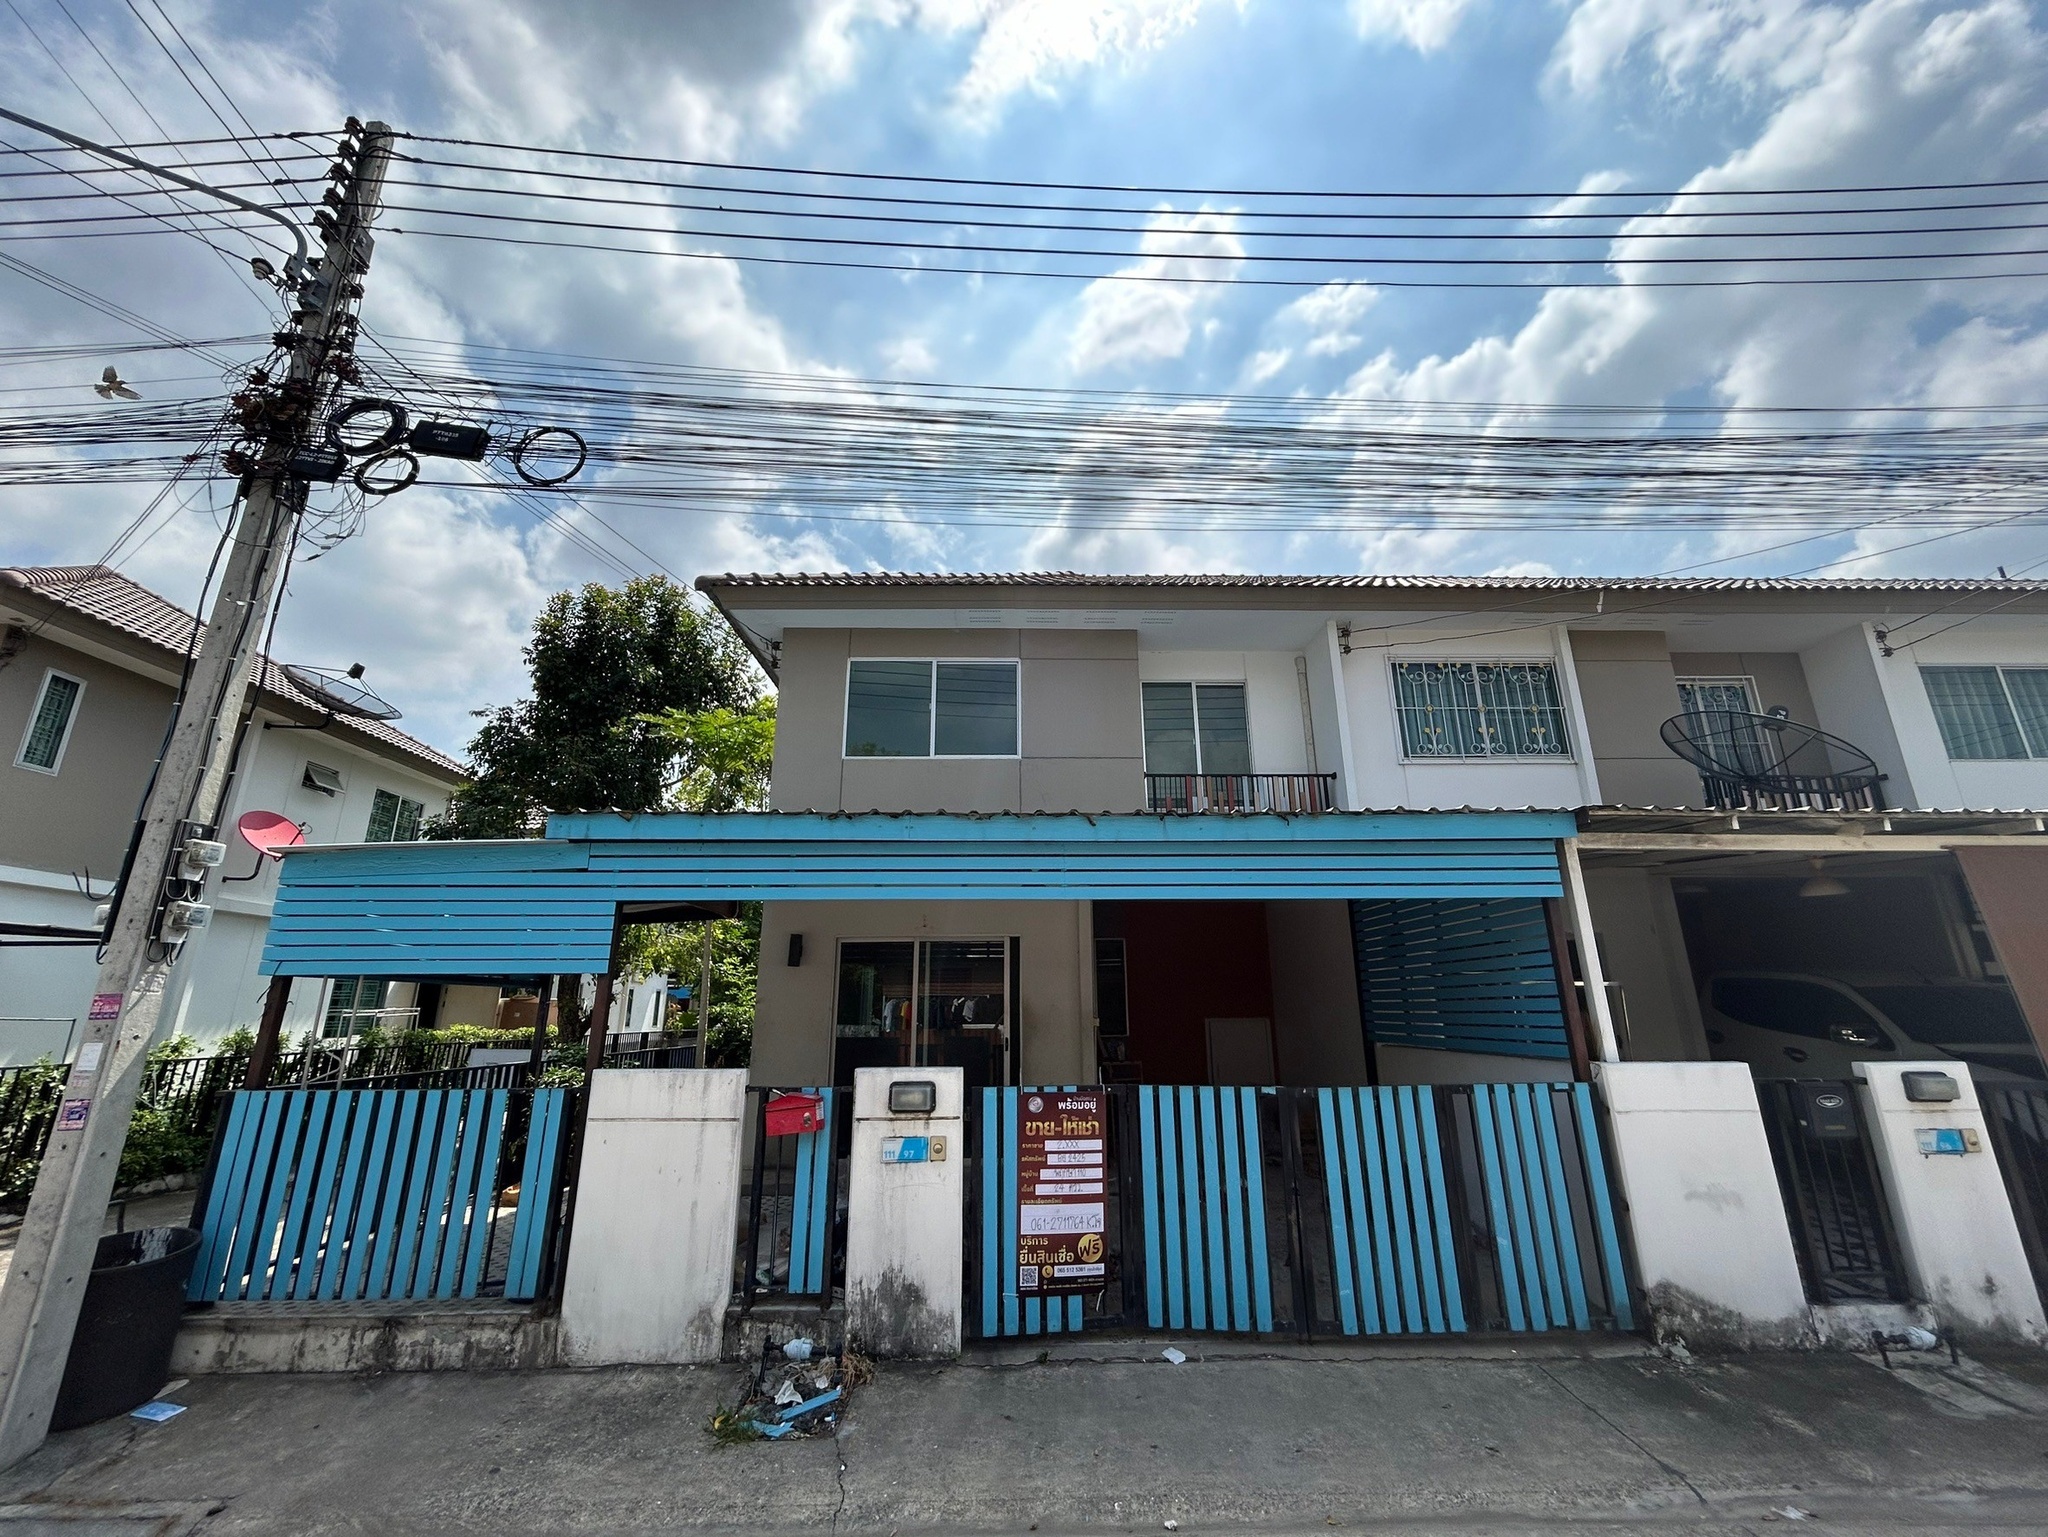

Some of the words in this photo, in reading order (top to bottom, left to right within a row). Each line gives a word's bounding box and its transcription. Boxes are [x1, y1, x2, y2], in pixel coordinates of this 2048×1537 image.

[1058, 1098, 1096, 1113] พร้อมอยู่
[1026, 1114, 1099, 1136] ขาย-ให้เช่า
[904, 1150, 914, 1158] 97
[1021, 1169, 1039, 1179] หมู่บ้าน
[1020, 1236, 1049, 1245] บริการ
[1080, 1239, 1100, 1257] ฟรี
[1020, 1245, 1074, 1264] ยื่นสินเชื่อ
